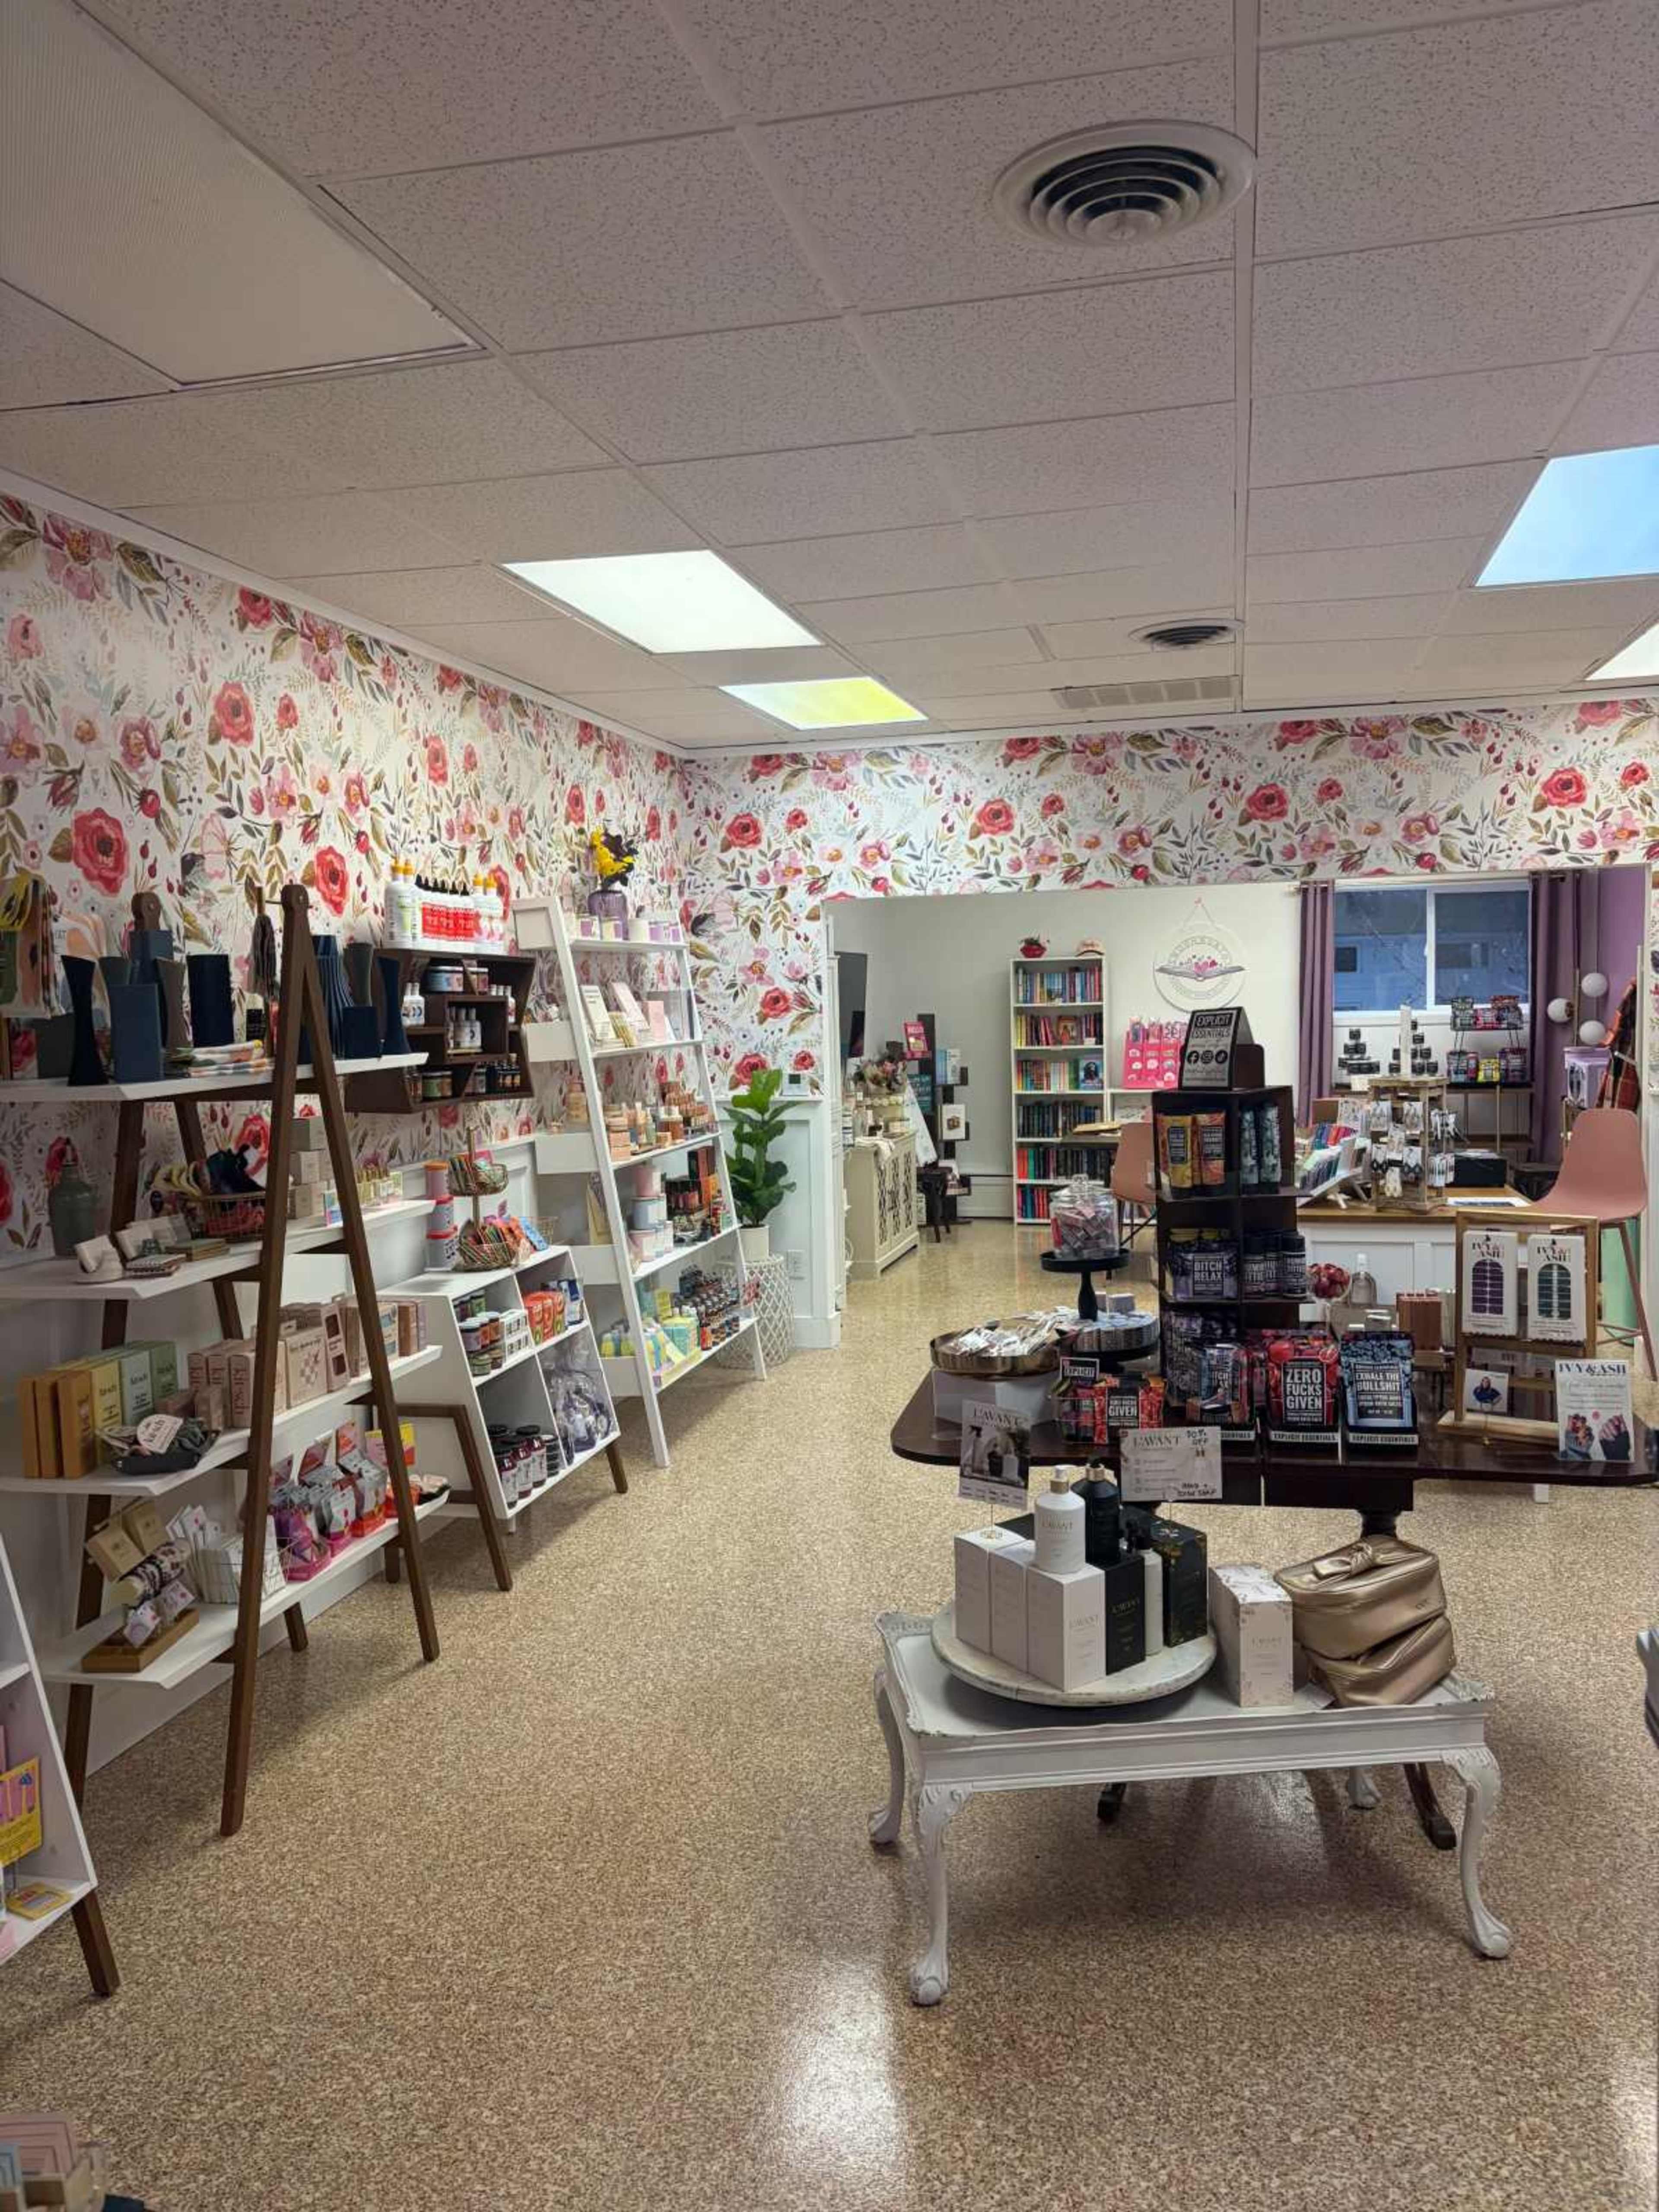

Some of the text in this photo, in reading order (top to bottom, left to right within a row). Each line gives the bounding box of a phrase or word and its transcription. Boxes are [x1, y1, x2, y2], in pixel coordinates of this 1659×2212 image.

[1196, 1015, 1230, 1027] EXPLICIT
[1194, 1262, 1222, 1271] BITCH
[1194, 1271, 1222, 1281] RELAX
[1286, 1368, 1322, 1383] ZERO
[1286, 1383, 1322, 1395] FUCKS
[1357, 1381, 1400, 1391] BULLSHIT
[1287, 1396, 1322, 1409] GIVEN
[1109, 1406, 1137, 1416] GIVEN
